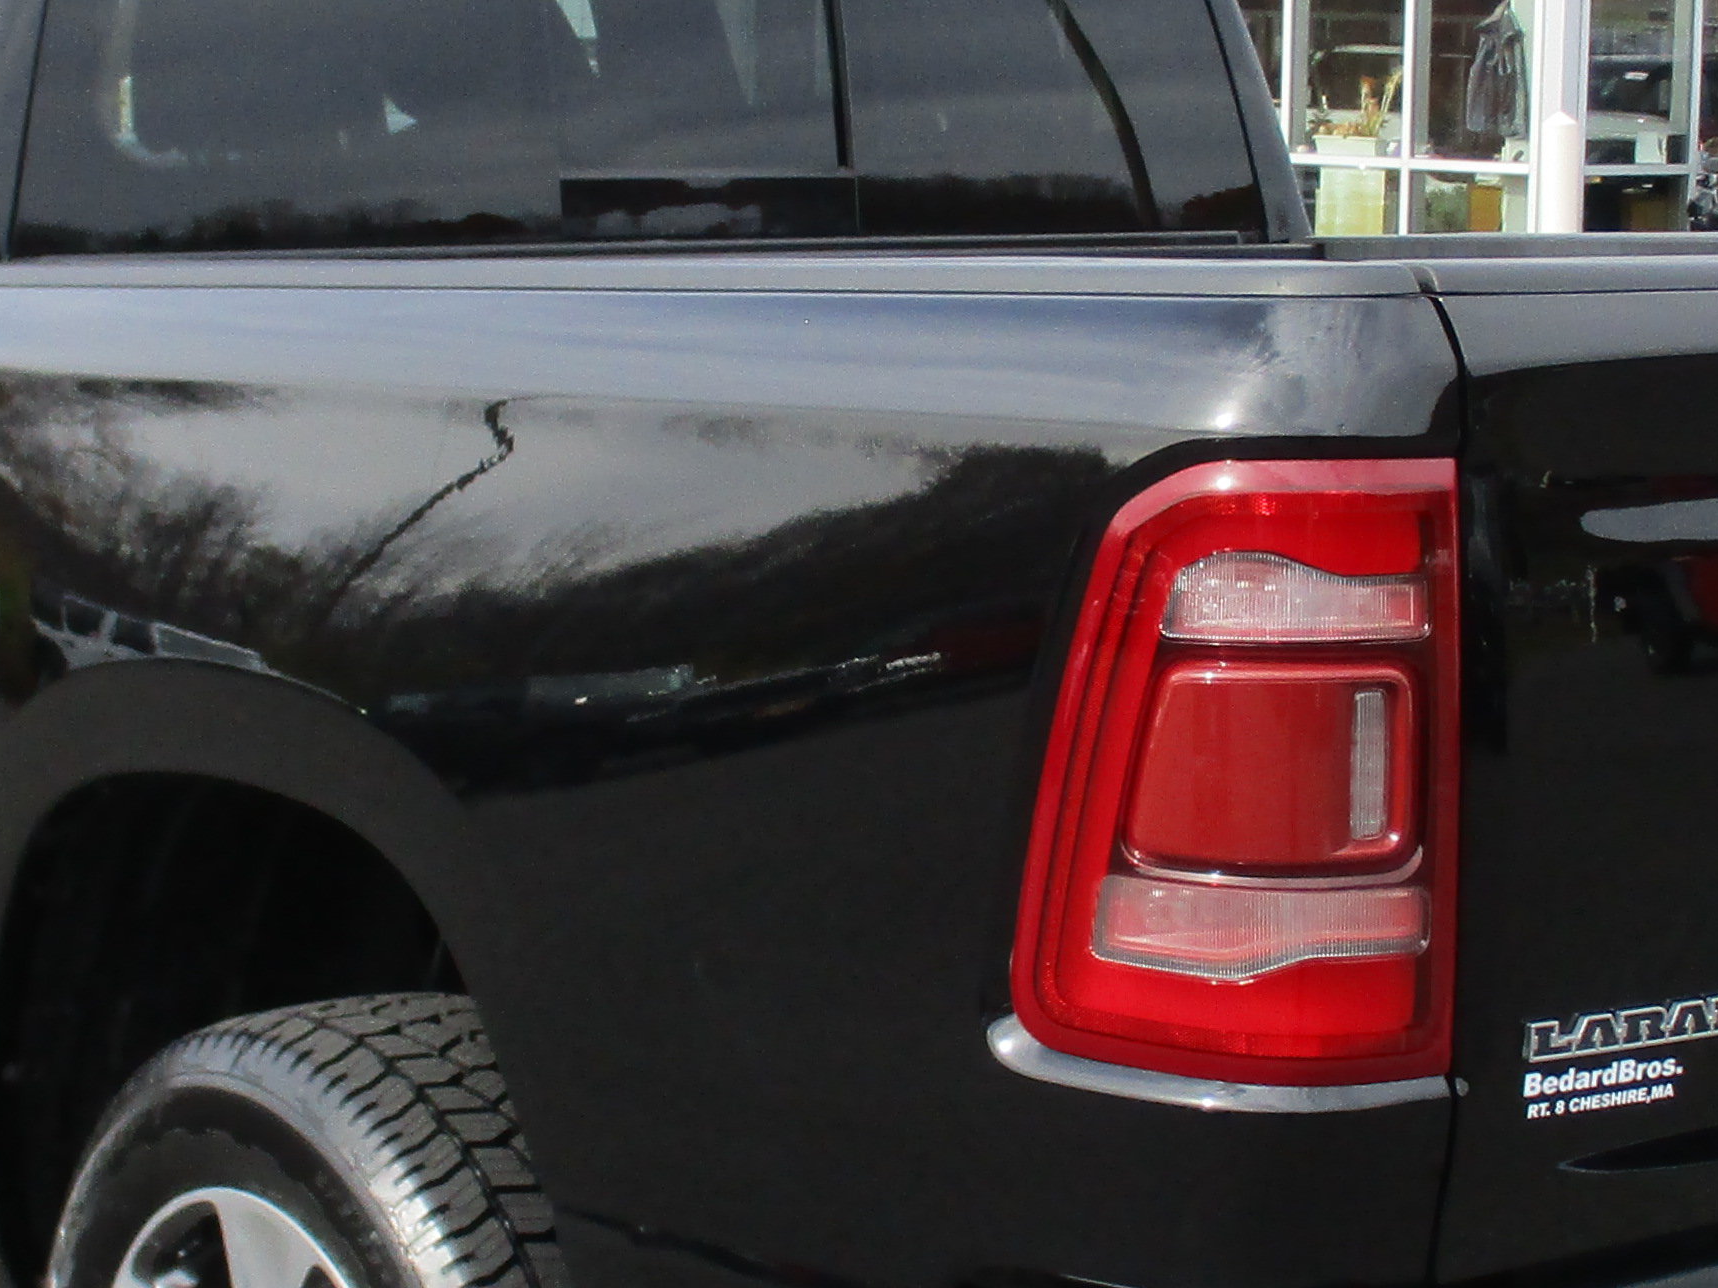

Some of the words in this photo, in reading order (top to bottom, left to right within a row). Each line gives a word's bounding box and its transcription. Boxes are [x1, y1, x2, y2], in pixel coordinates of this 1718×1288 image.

[1523, 1058, 1683, 1098] BedardBros.
[1527, 1102, 1552, 1119] RT.
[1555, 1100, 1566, 1114] 8
[1569, 1083, 1675, 1112] CHESHIRE,MA
